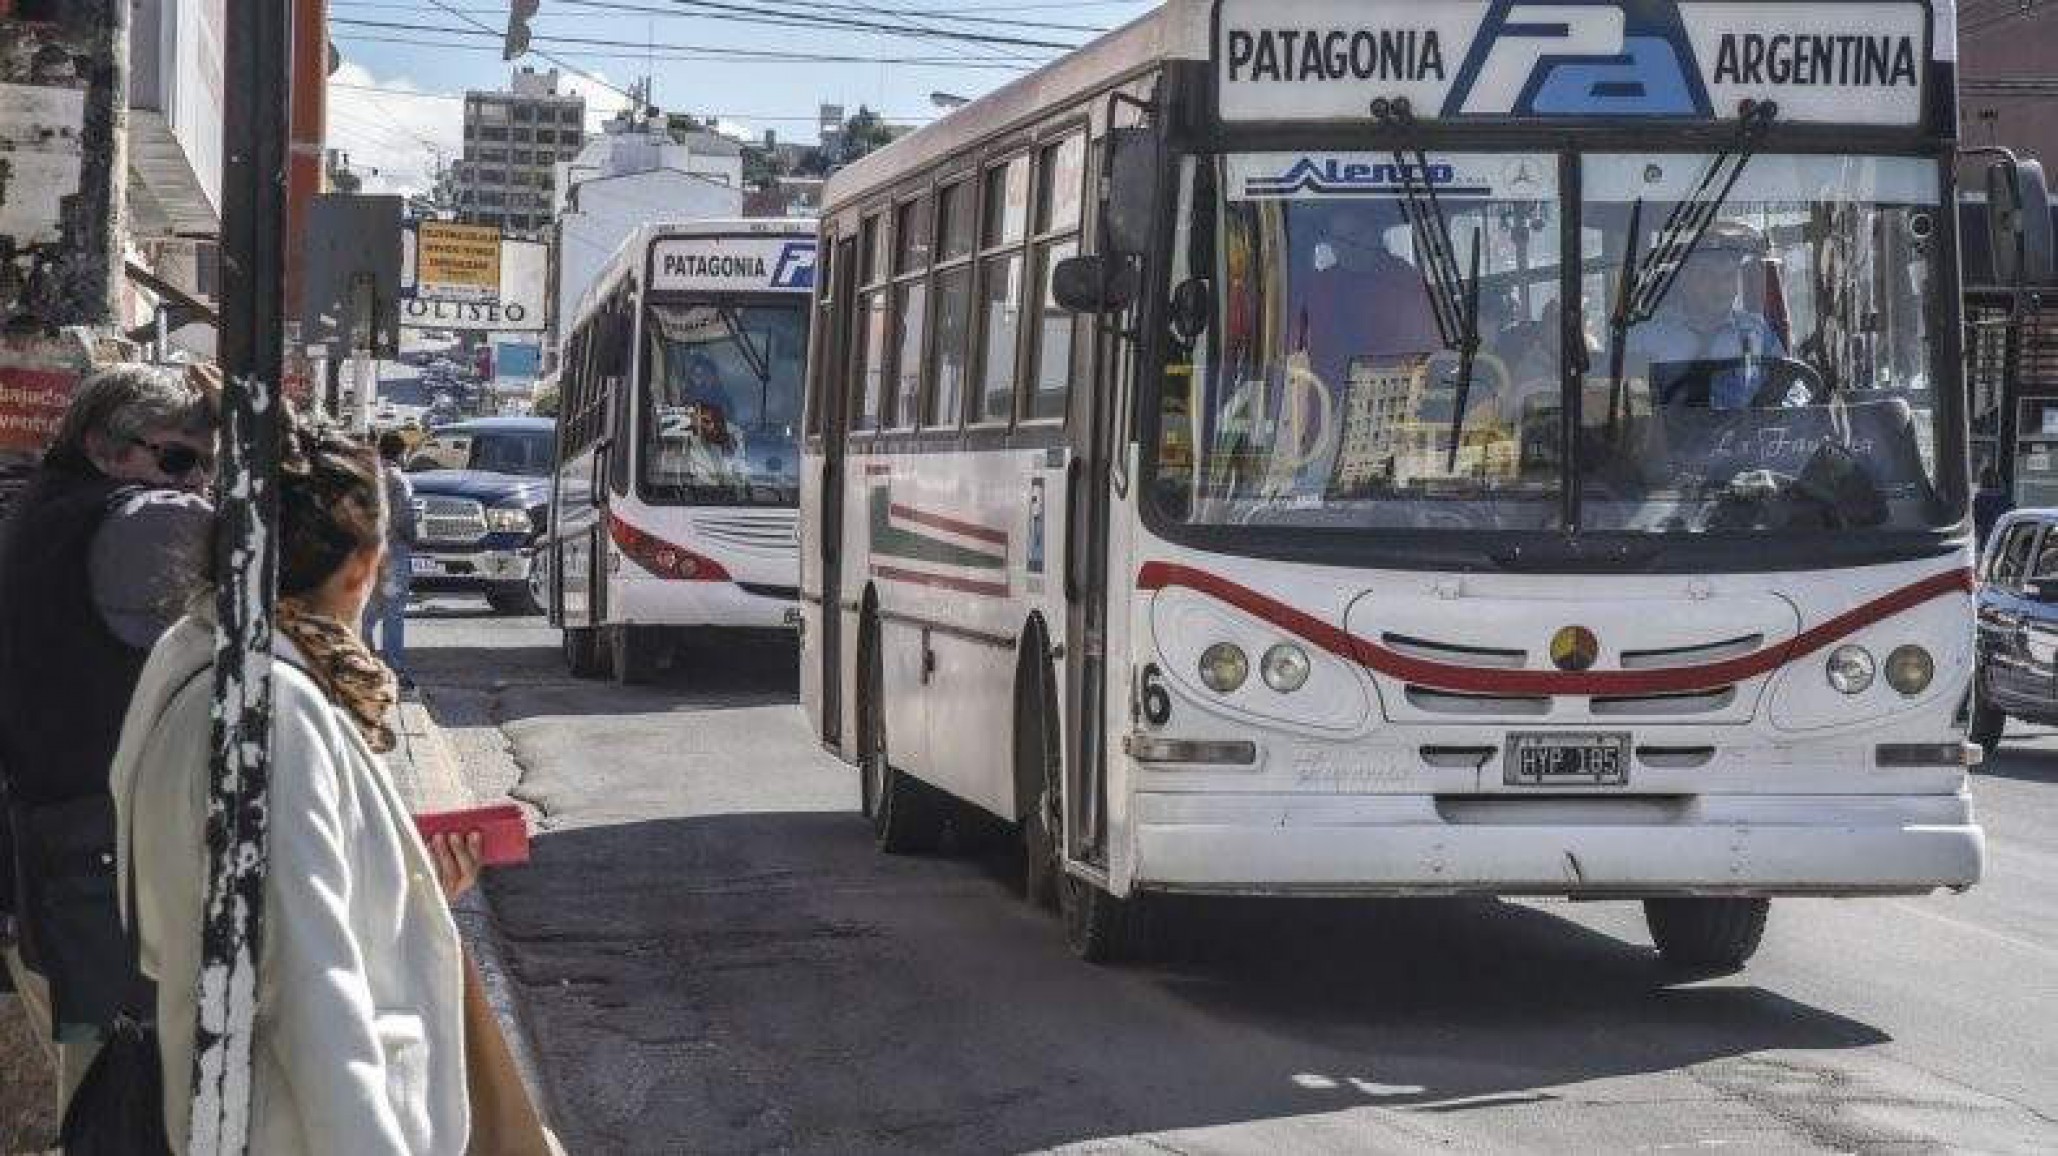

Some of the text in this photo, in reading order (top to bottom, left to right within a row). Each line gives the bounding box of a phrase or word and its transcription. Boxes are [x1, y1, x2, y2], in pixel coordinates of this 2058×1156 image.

[1228, 29, 1445, 82] PATAGONIA
[1713, 33, 1918, 87] ARGENTINA
[663, 255, 767, 278] PATAGONIA
[407, 299, 525, 322] OLISEO
[1523, 748, 1617, 773] HYP 185
